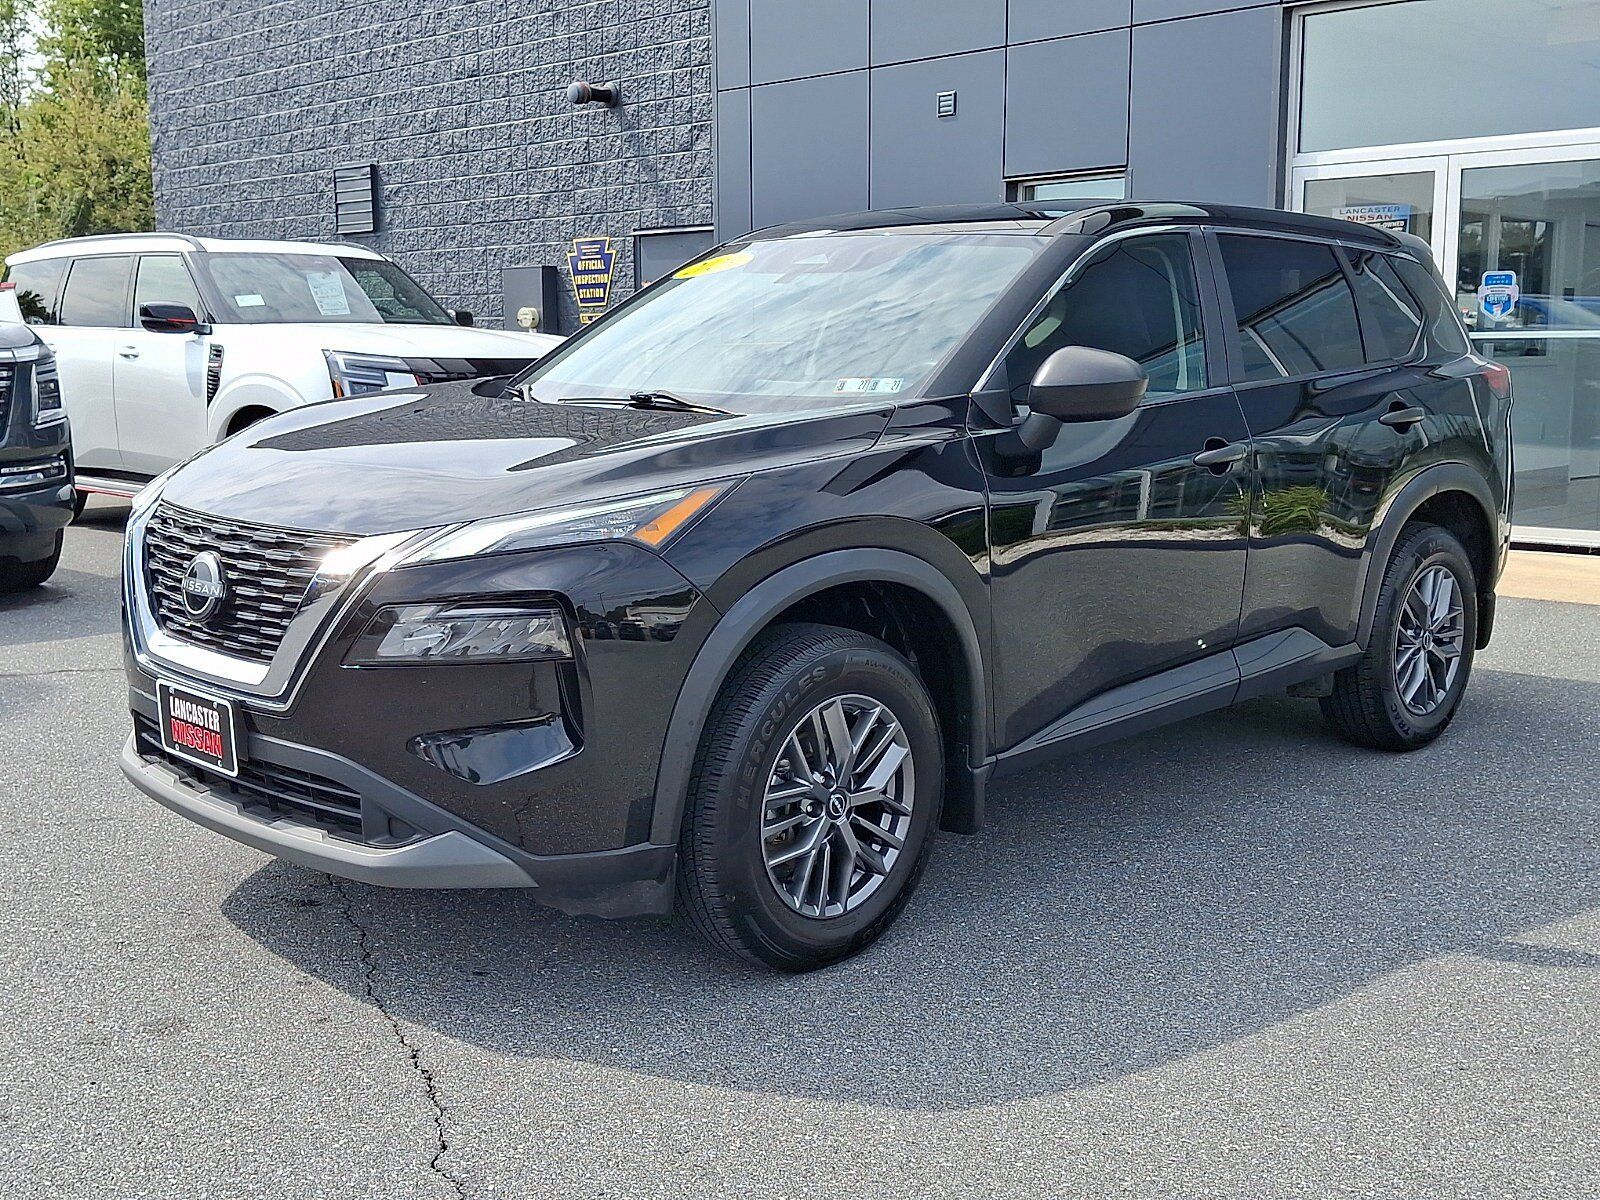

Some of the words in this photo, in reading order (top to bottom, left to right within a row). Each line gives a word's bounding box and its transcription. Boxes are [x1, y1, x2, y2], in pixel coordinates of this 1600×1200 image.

[1339, 206, 1400, 215] LANCASTER
[1347, 214, 1393, 222] NISSAN
[577, 259, 605, 271] OFFICIAL
[575, 274, 608, 285] INSPECTION
[579, 288, 604, 299] STATION
[183, 579, 220, 596] NISSAN
[169, 695, 220, 733] LANCASTER
[170, 718, 223, 759] NISSAN
[737, 664, 827, 808] HERCULES
